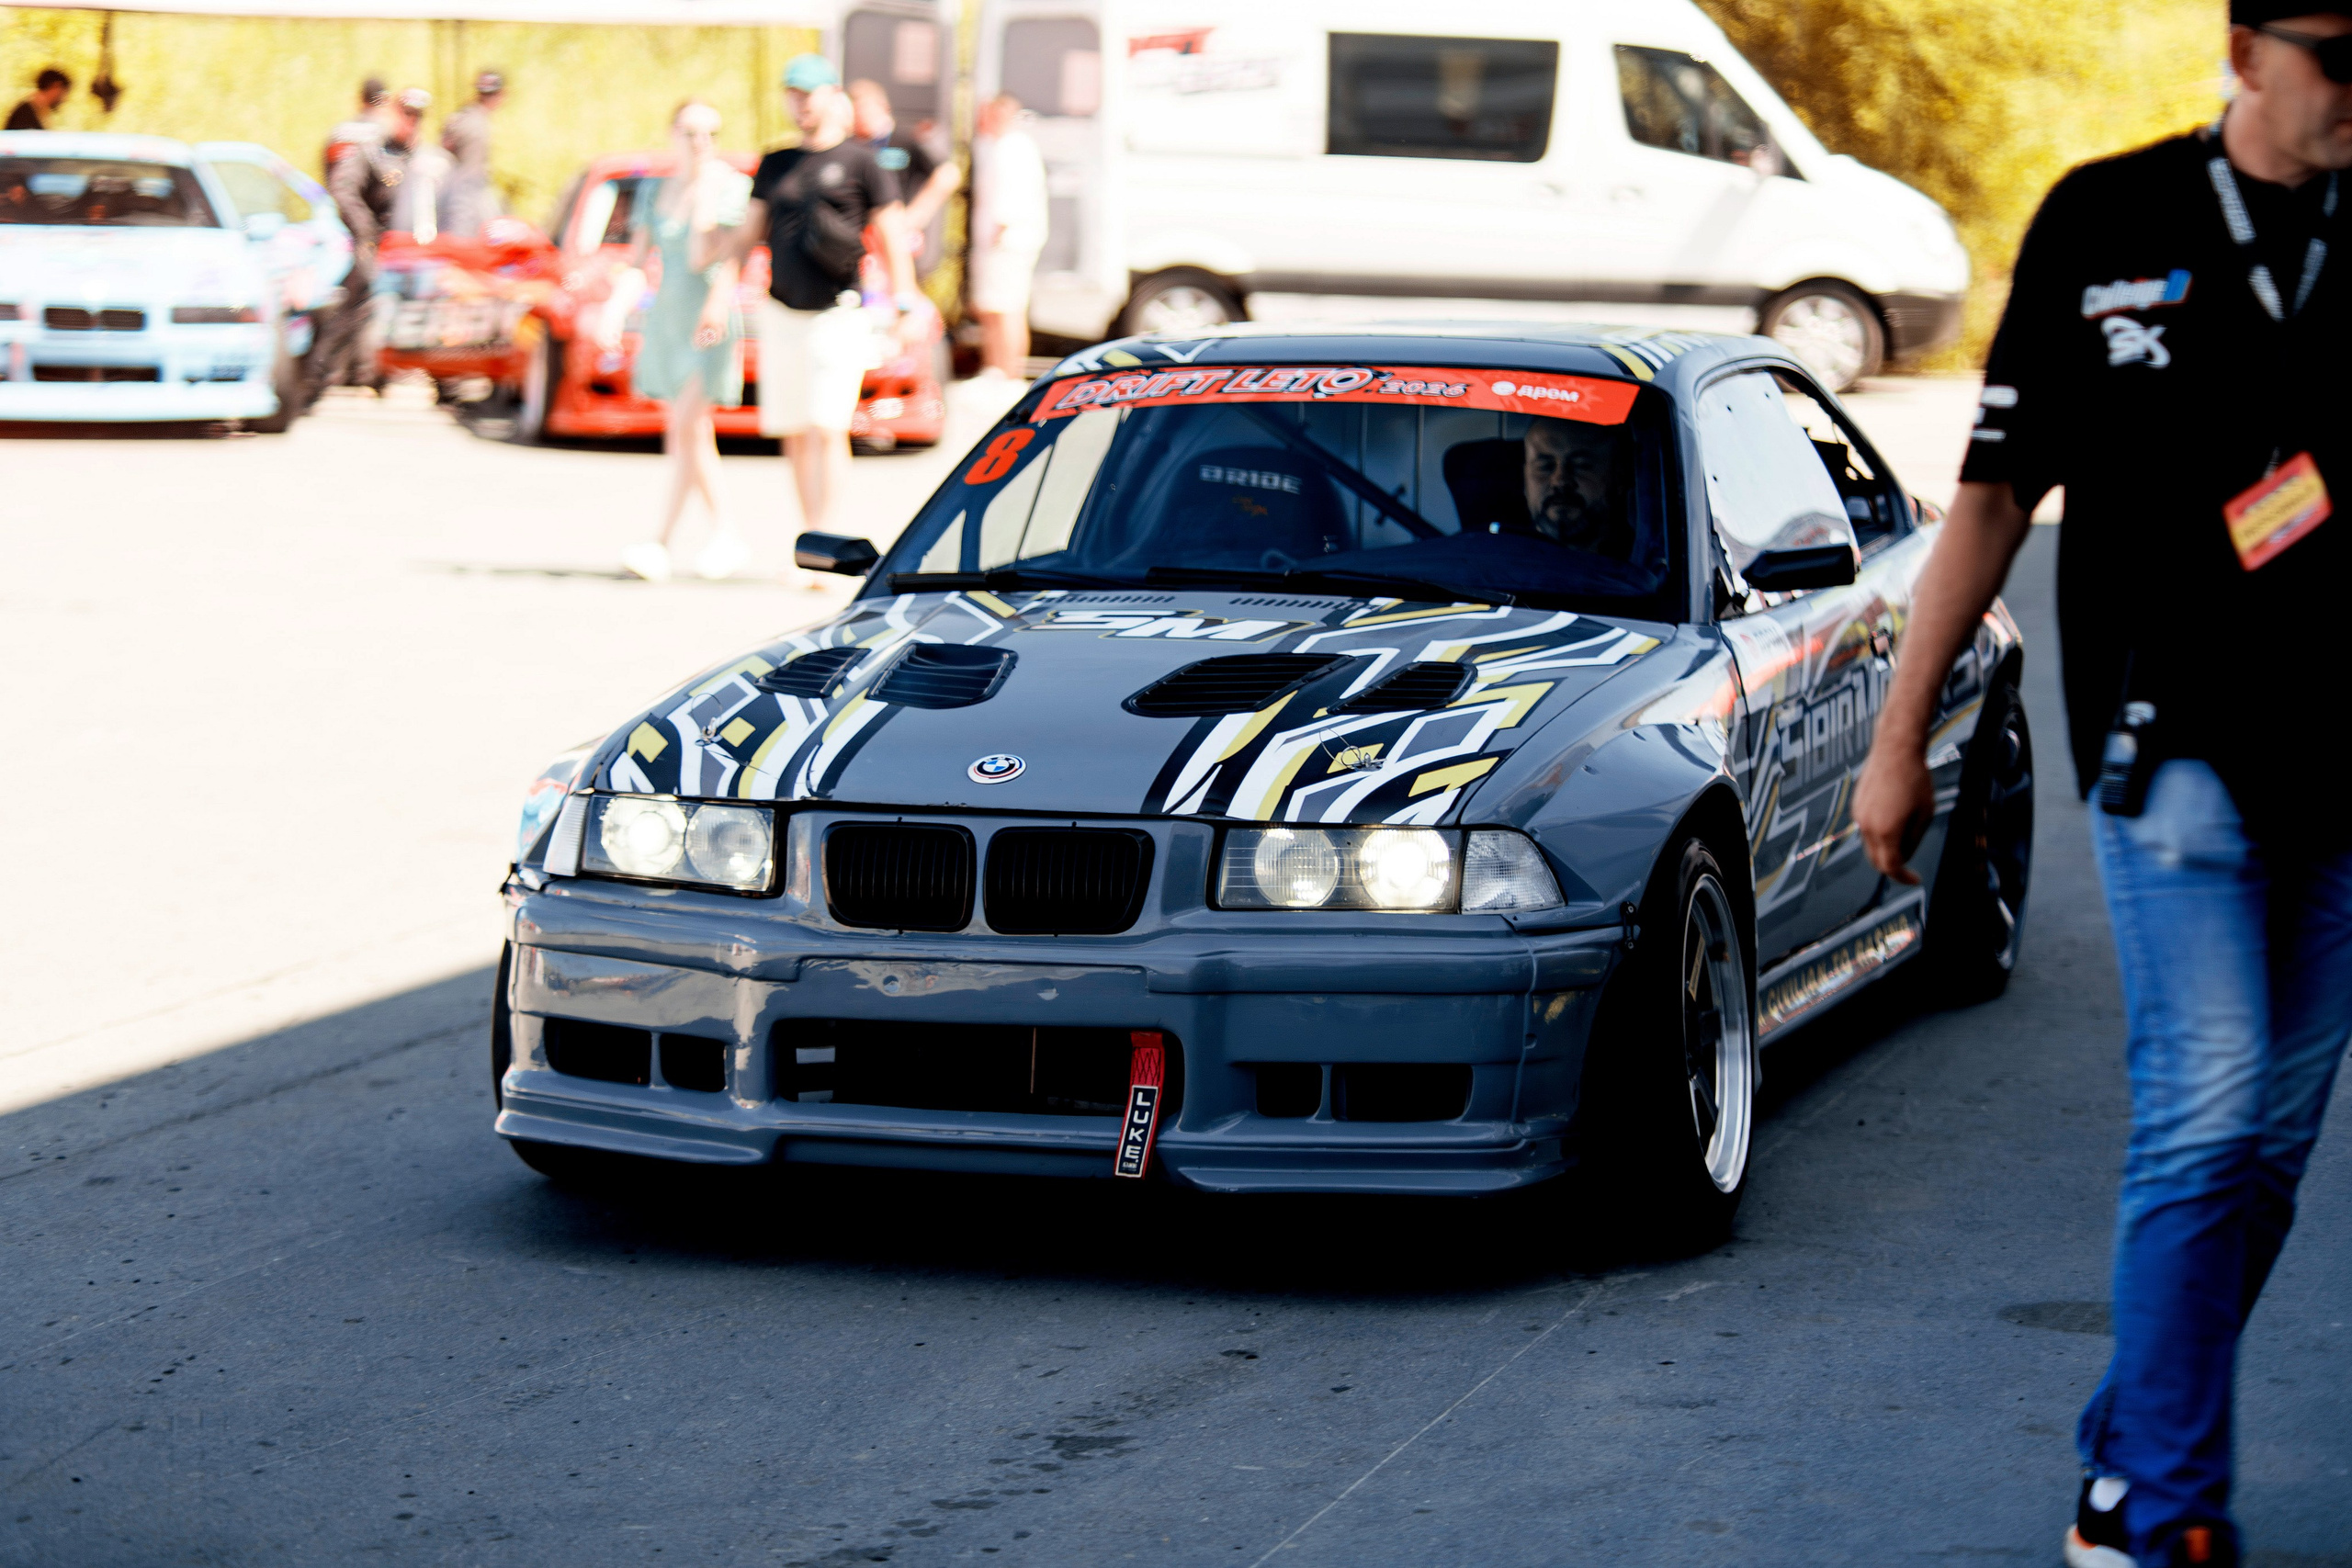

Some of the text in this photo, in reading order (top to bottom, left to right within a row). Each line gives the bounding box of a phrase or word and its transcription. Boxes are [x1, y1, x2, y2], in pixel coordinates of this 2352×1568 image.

[1056, 368, 1233, 411] DRIFT
[1222, 367, 1374, 397] LETO
[963, 428, 1036, 486] 8
[1124, 1091, 1151, 1159] LUKE
